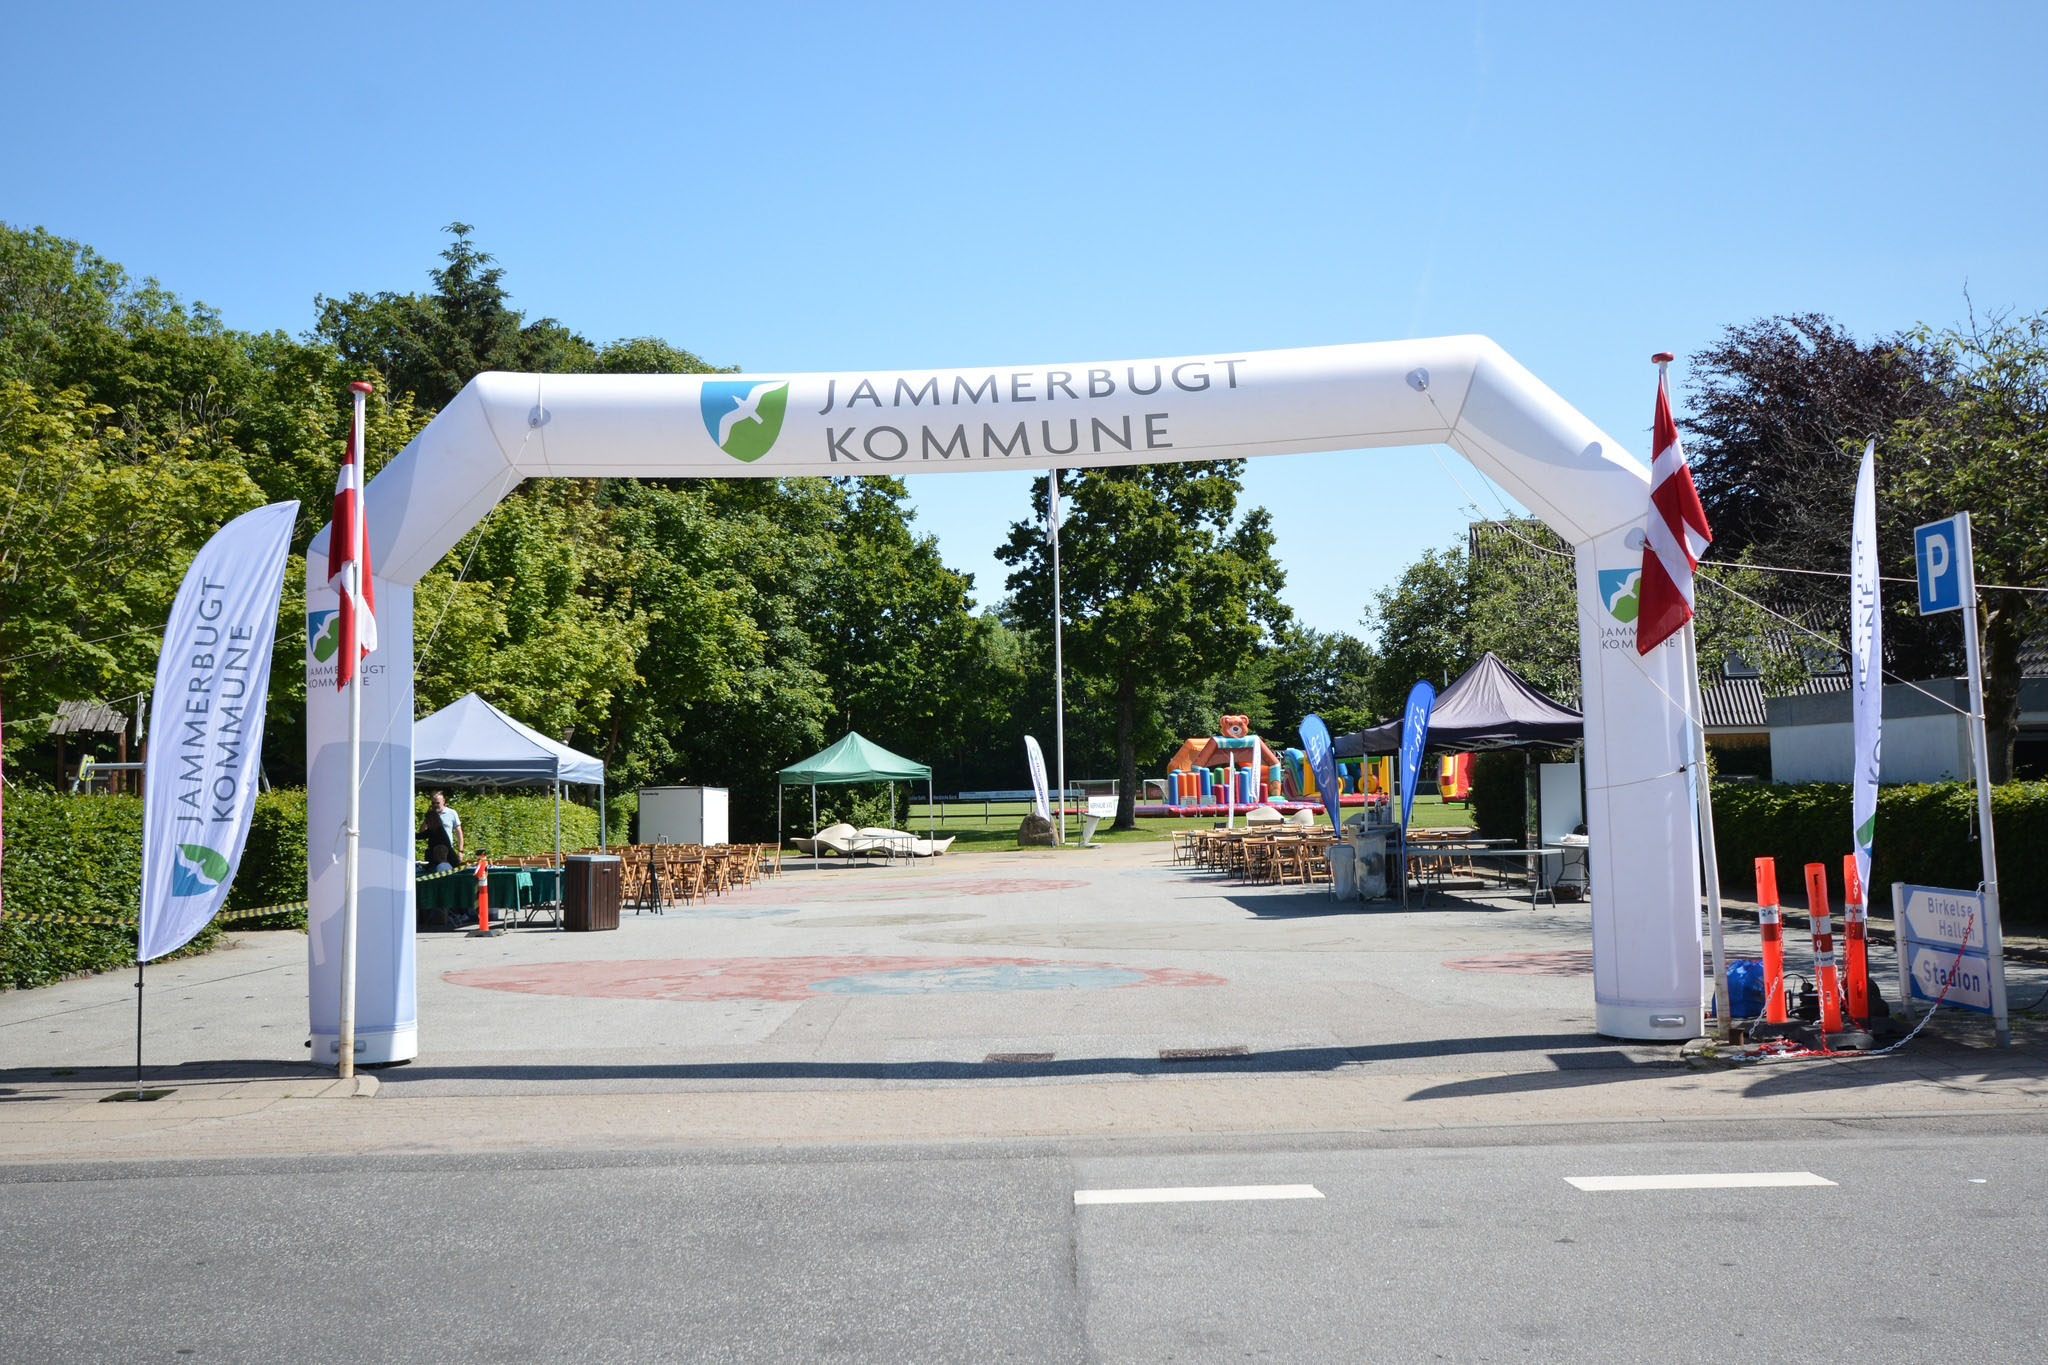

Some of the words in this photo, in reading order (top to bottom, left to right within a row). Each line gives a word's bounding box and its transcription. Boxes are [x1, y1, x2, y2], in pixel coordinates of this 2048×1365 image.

[817, 359, 1247, 415] JAMMERBUGT
[826, 412, 1173, 462] KOMMUNE
[1925, 533, 1949, 602] P
[177, 576, 225, 826] JAMMERBUGT
[211, 625, 253, 822] KOMMUNE
[1927, 897, 1973, 918] Birkelse
[1939, 919, 1975, 941] Hallen
[1923, 960, 1980, 993] Stadion
